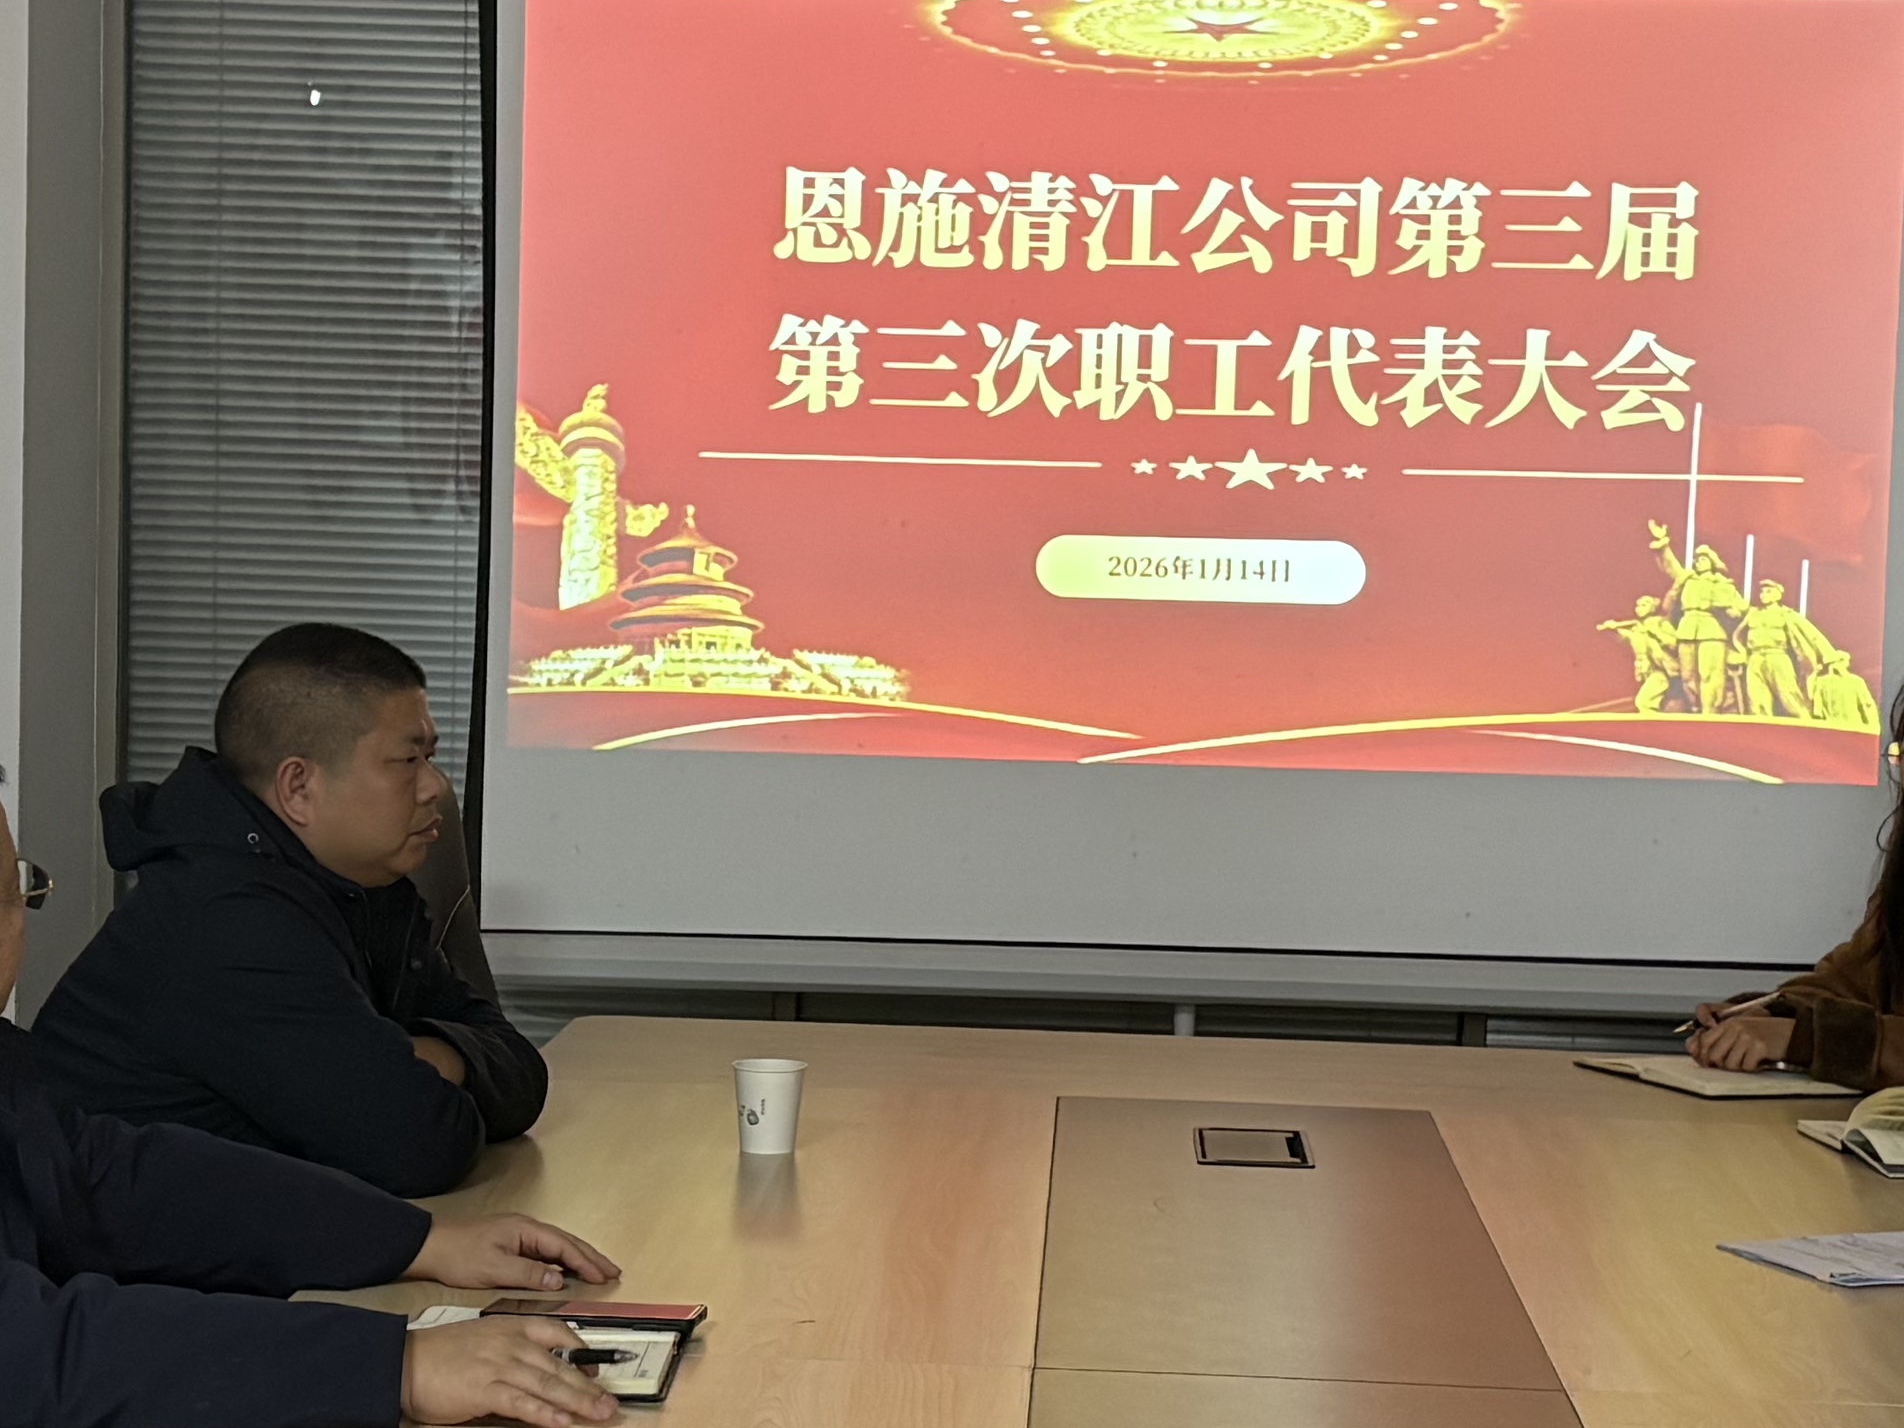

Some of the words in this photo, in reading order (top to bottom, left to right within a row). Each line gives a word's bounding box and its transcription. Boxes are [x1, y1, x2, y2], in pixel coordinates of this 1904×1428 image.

[774, 166, 1700, 282] 恩施清江公司第三届
[769, 313, 1696, 432] 第三次职工代表大会
[1108, 552, 1293, 584] 2026年1月14日
